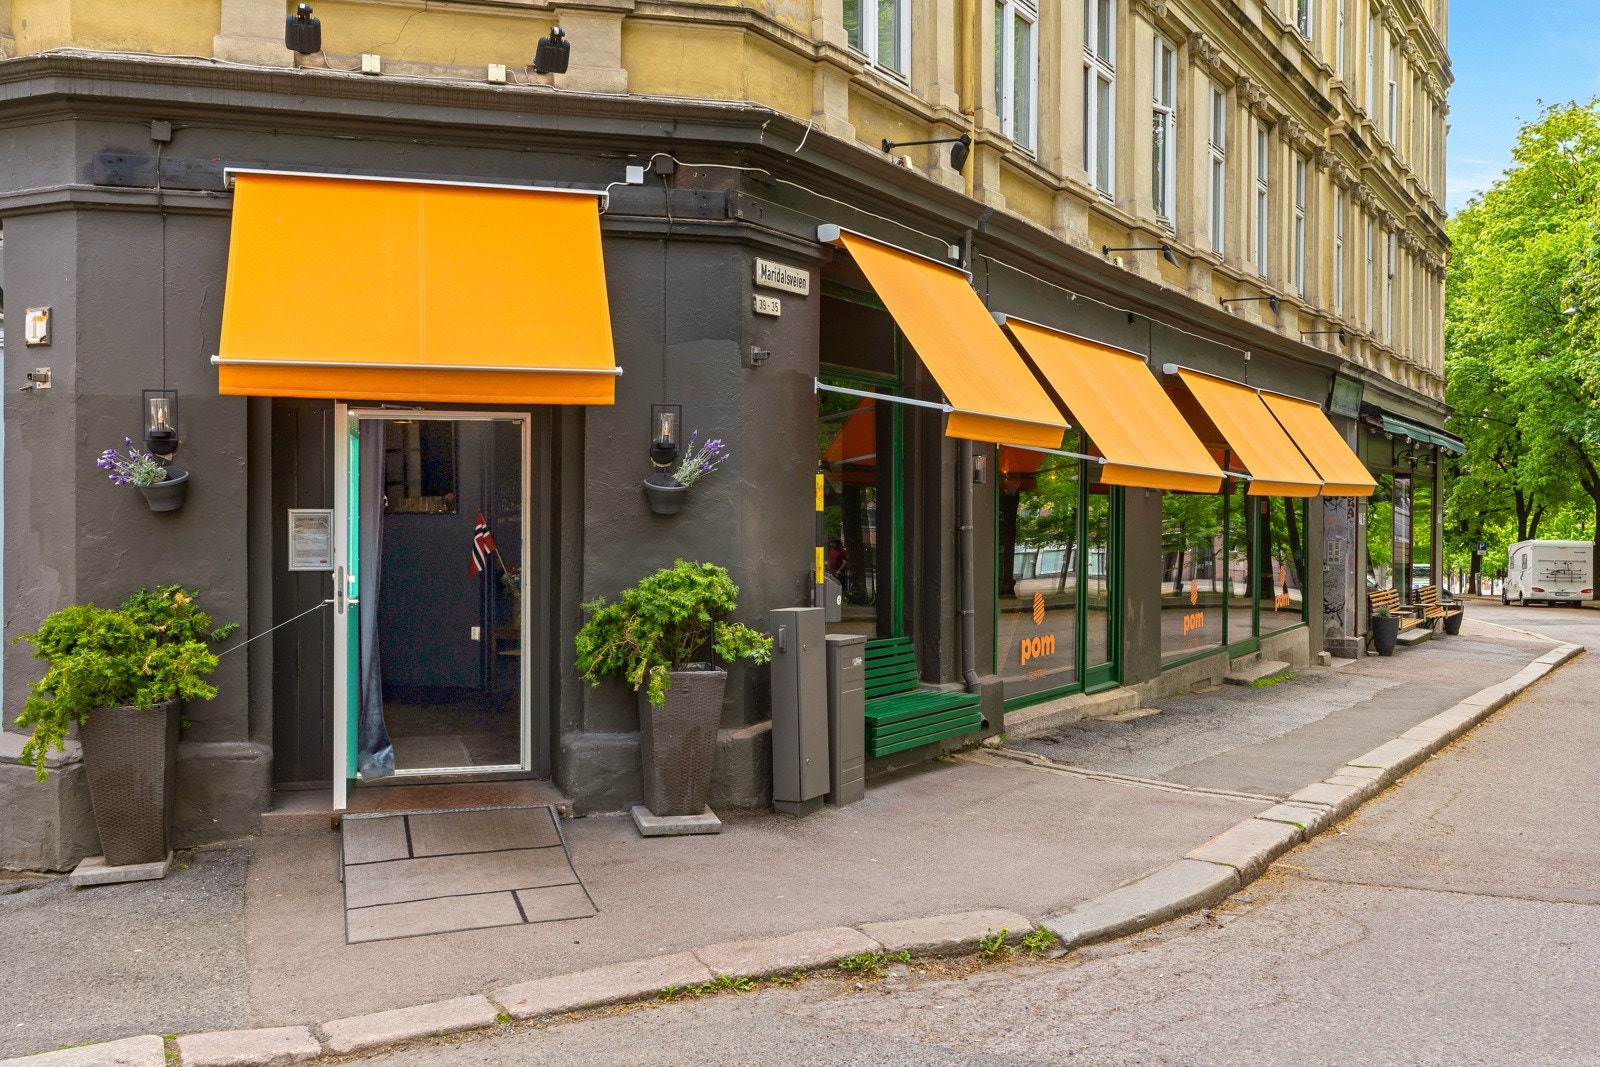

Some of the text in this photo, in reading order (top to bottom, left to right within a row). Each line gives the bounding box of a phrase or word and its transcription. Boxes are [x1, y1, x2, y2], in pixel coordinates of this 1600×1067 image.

[760, 263, 807, 290] Maridalsveien
[1274, 592, 1290, 612] pom
[1183, 611, 1204, 636] pom
[1021, 633, 1055, 666] pom
